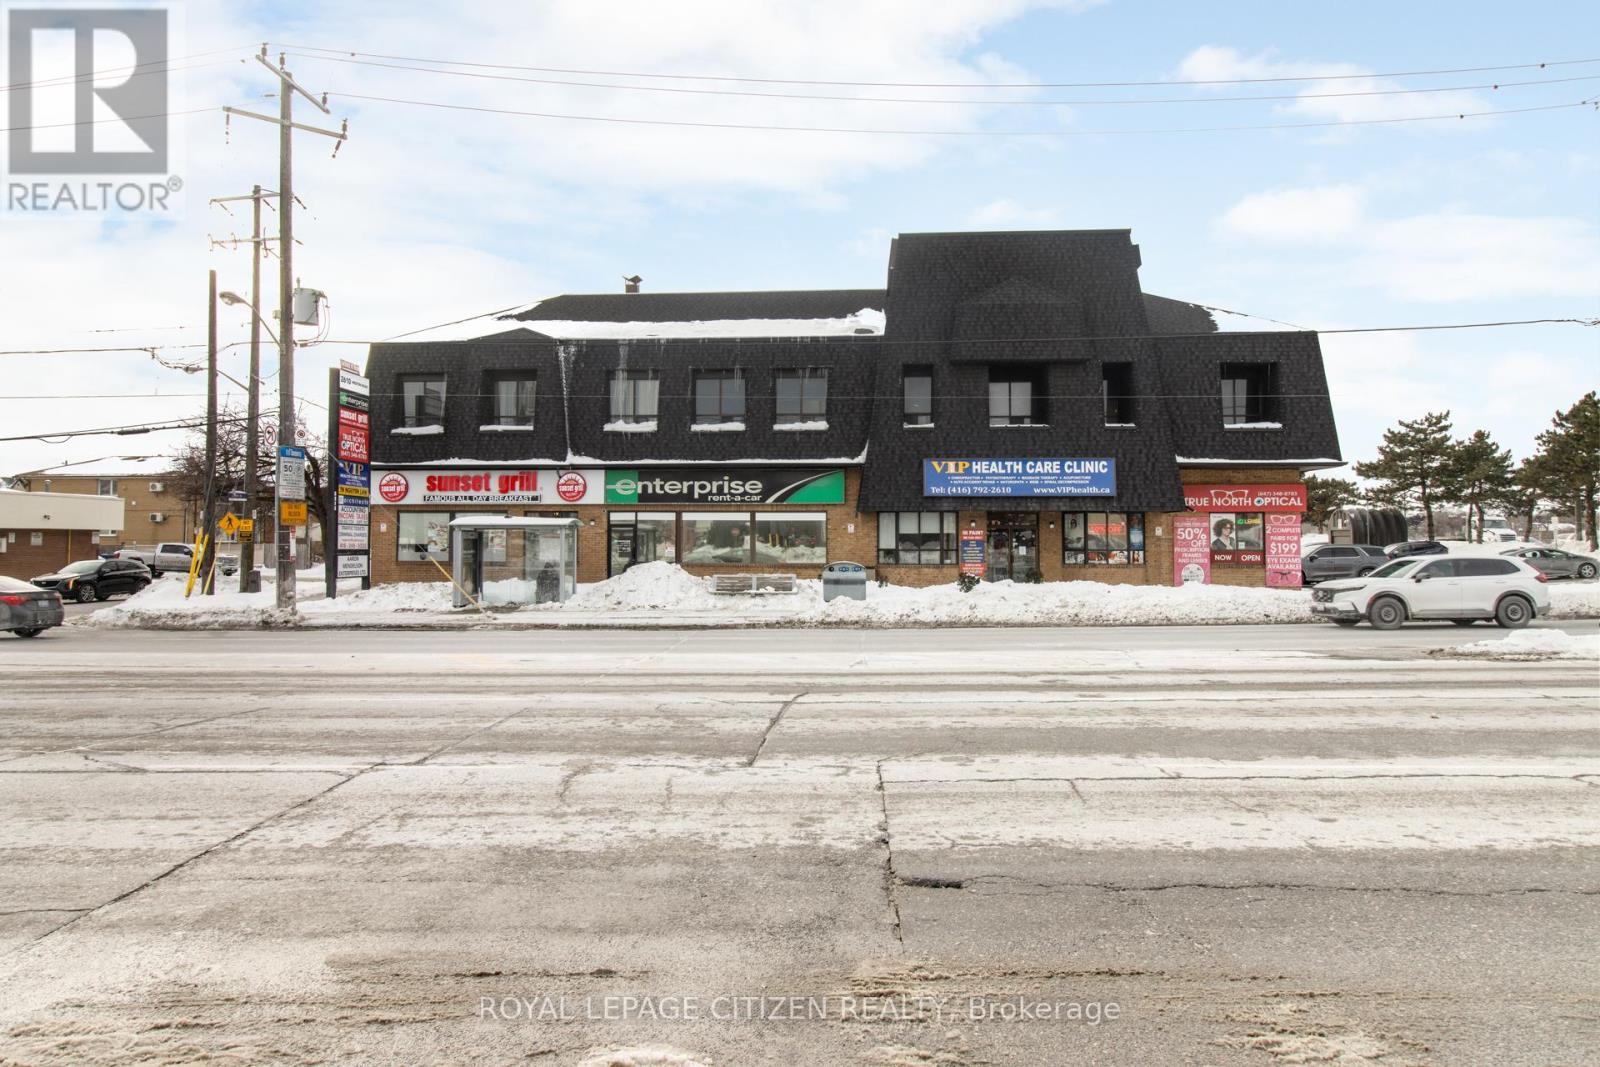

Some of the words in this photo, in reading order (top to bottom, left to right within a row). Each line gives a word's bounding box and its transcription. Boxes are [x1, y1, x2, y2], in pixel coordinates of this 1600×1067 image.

[341, 440, 367, 454] OPTICAL
[284, 464, 293, 473] 50
[931, 461, 970, 474] VIP
[972, 461, 1023, 474] HEALTH
[1026, 461, 1061, 474] CARE
[1064, 460, 1109, 474] CLINIC
[426, 472, 491, 493] sunset
[498, 471, 539, 495] grill
[606, 475, 763, 499] enterprise
[930, 486, 946, 494] Tel:
[947, 486, 971, 495] (416)
[973, 486, 1012, 494] 792-2610
[1033, 486, 1111, 494] www.VIPhealth.ca
[425, 494, 456, 502] FAMOUS
[457, 494, 469, 502] ALL
[472, 494, 487, 502] DAY
[488, 494, 533, 502] BREAKFAST
[708, 494, 762, 502] rent-a-car
[1212, 497, 1252, 507] NORTH
[1253, 496, 1303, 507] OPTICAL
[1177, 527, 1207, 540] 50%
[1266, 525, 1272, 534] 2
[1190, 539, 1208, 548] OFF
[1270, 542, 1298, 554] $199
[1241, 554, 1261, 562] OPEN
